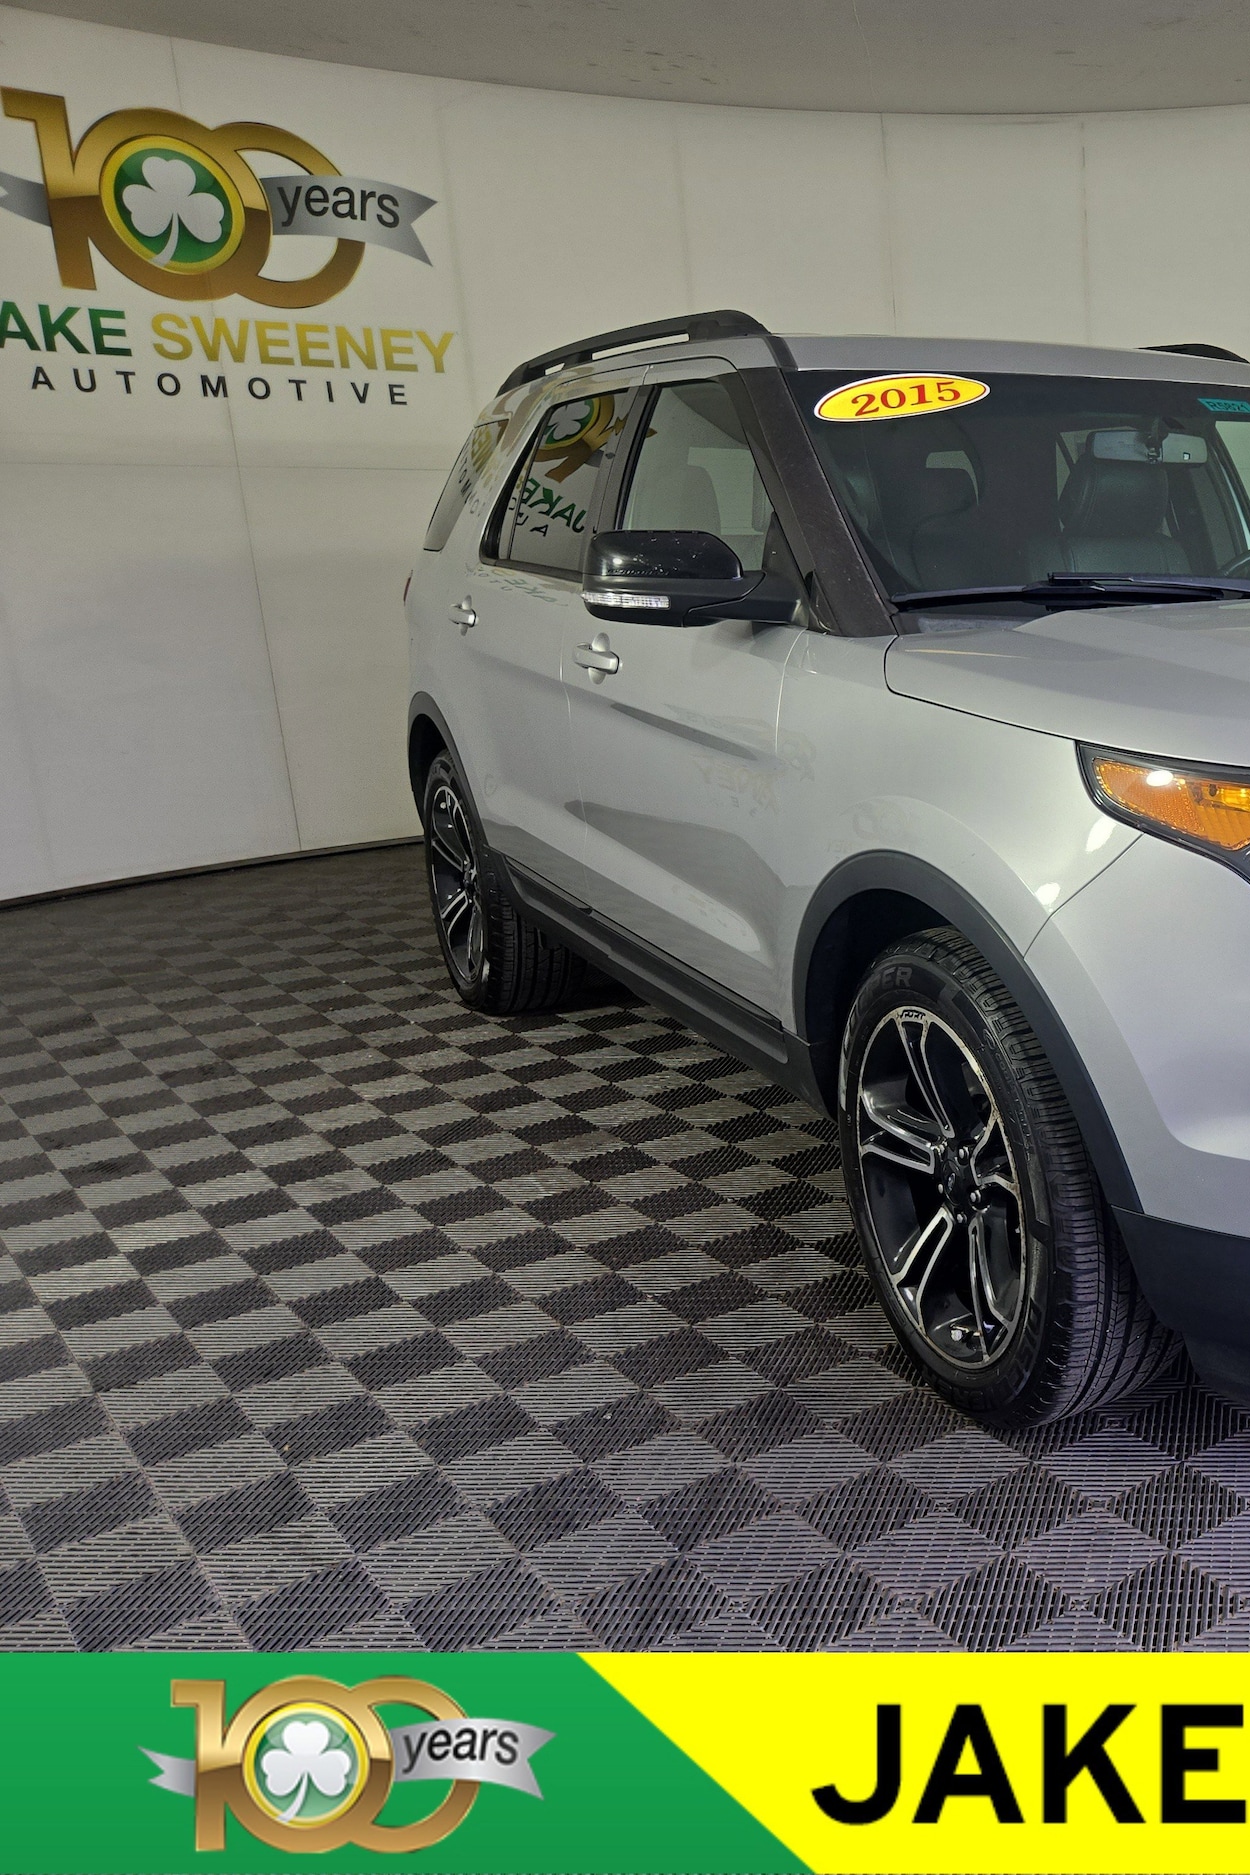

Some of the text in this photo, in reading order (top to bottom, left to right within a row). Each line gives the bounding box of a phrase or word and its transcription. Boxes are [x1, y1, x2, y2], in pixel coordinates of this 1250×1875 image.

[1, 86, 401, 309] 100 years
[0, 301, 455, 374] AKE SWEENEY
[31, 366, 409, 406] AUTOMOTIVE
[851, 381, 961, 416] 2015
